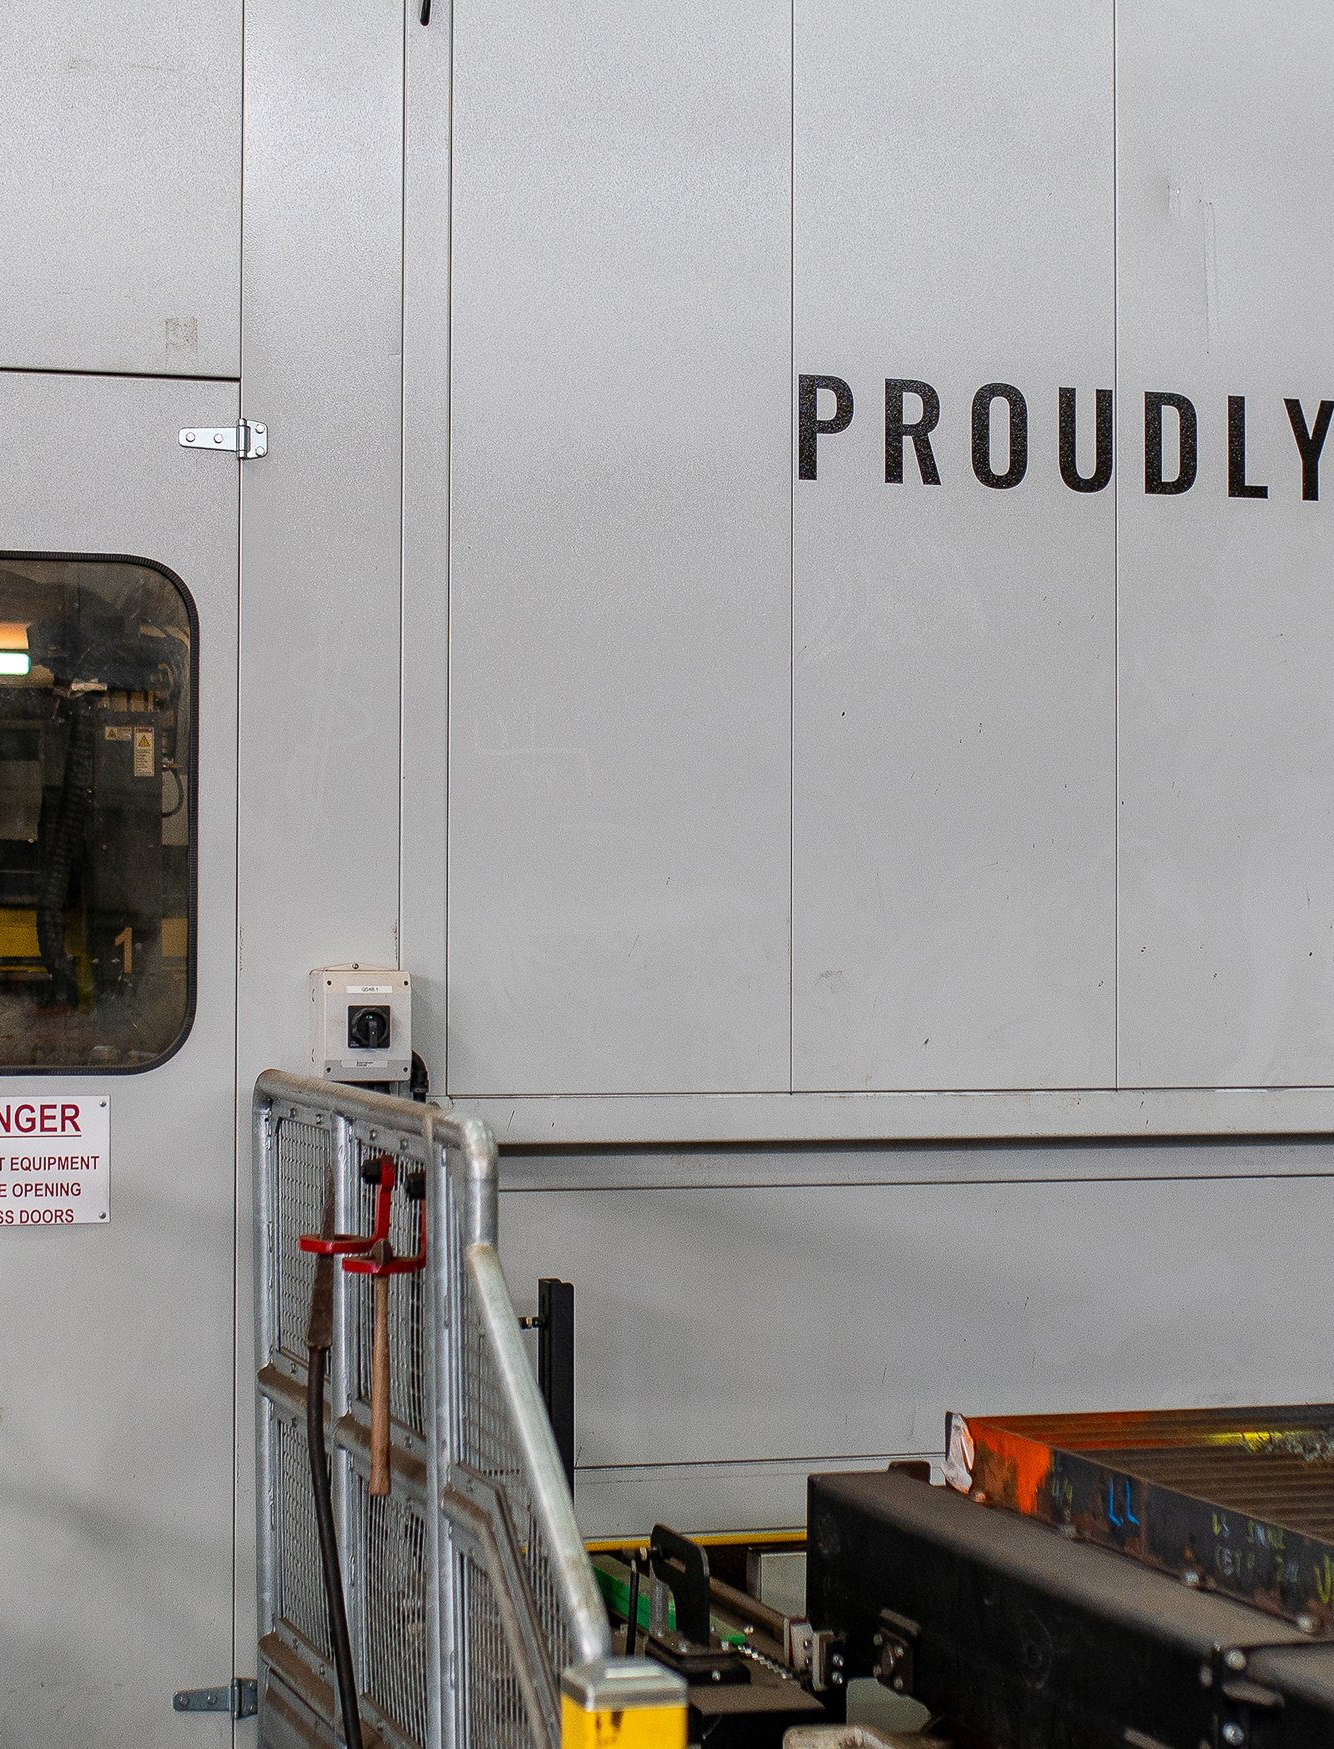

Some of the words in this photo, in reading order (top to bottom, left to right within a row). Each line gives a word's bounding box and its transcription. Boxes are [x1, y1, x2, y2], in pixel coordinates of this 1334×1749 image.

[114, 927, 133, 974] 1
[10, 1155, 100, 1171] EQUIPMENT
[12, 1182, 82, 1198] OPENING
[19, 1209, 75, 1225] DOORS
